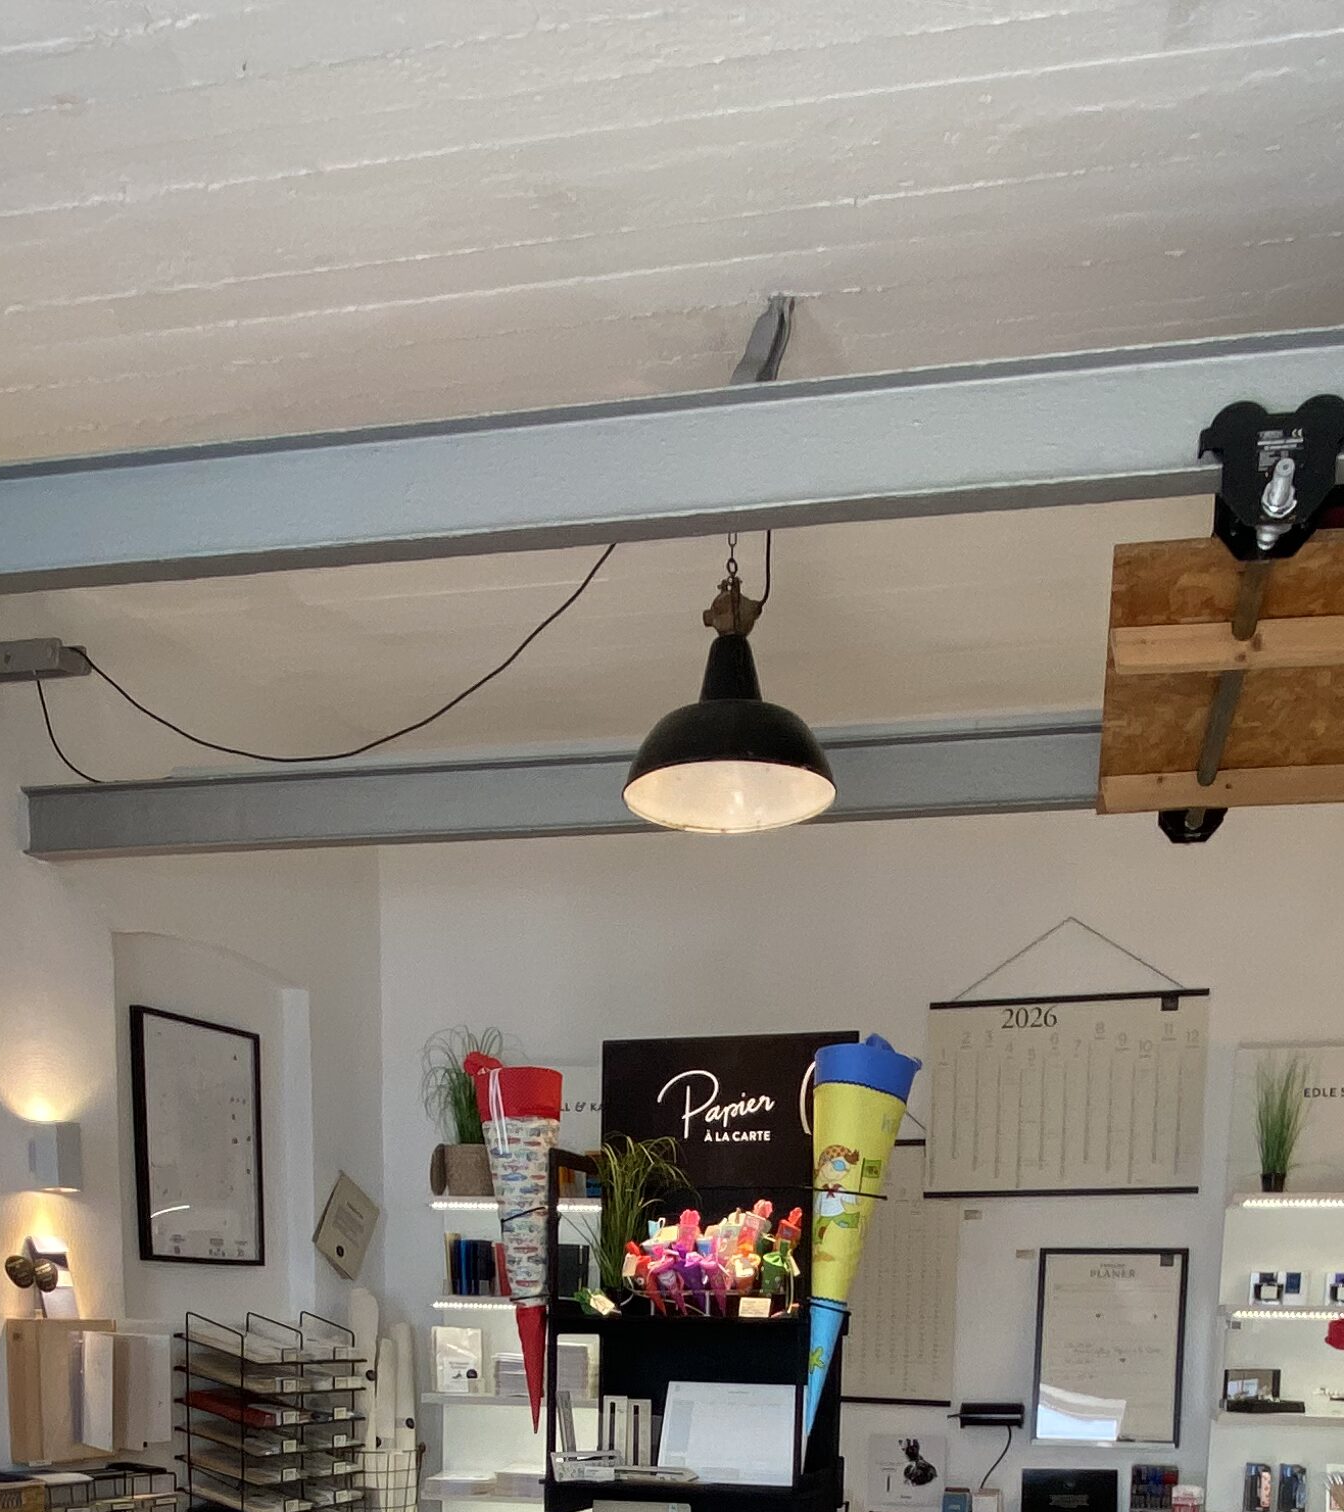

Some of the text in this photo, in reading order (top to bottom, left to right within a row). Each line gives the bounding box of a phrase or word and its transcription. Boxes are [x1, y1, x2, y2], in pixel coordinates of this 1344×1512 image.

[1001, 1007, 1057, 1029] 2026
[1303, 1086, 1337, 1098] EDLE
[657, 1070, 775, 1139] Papier
[704, 1129, 771, 1142] À LA CARTE
